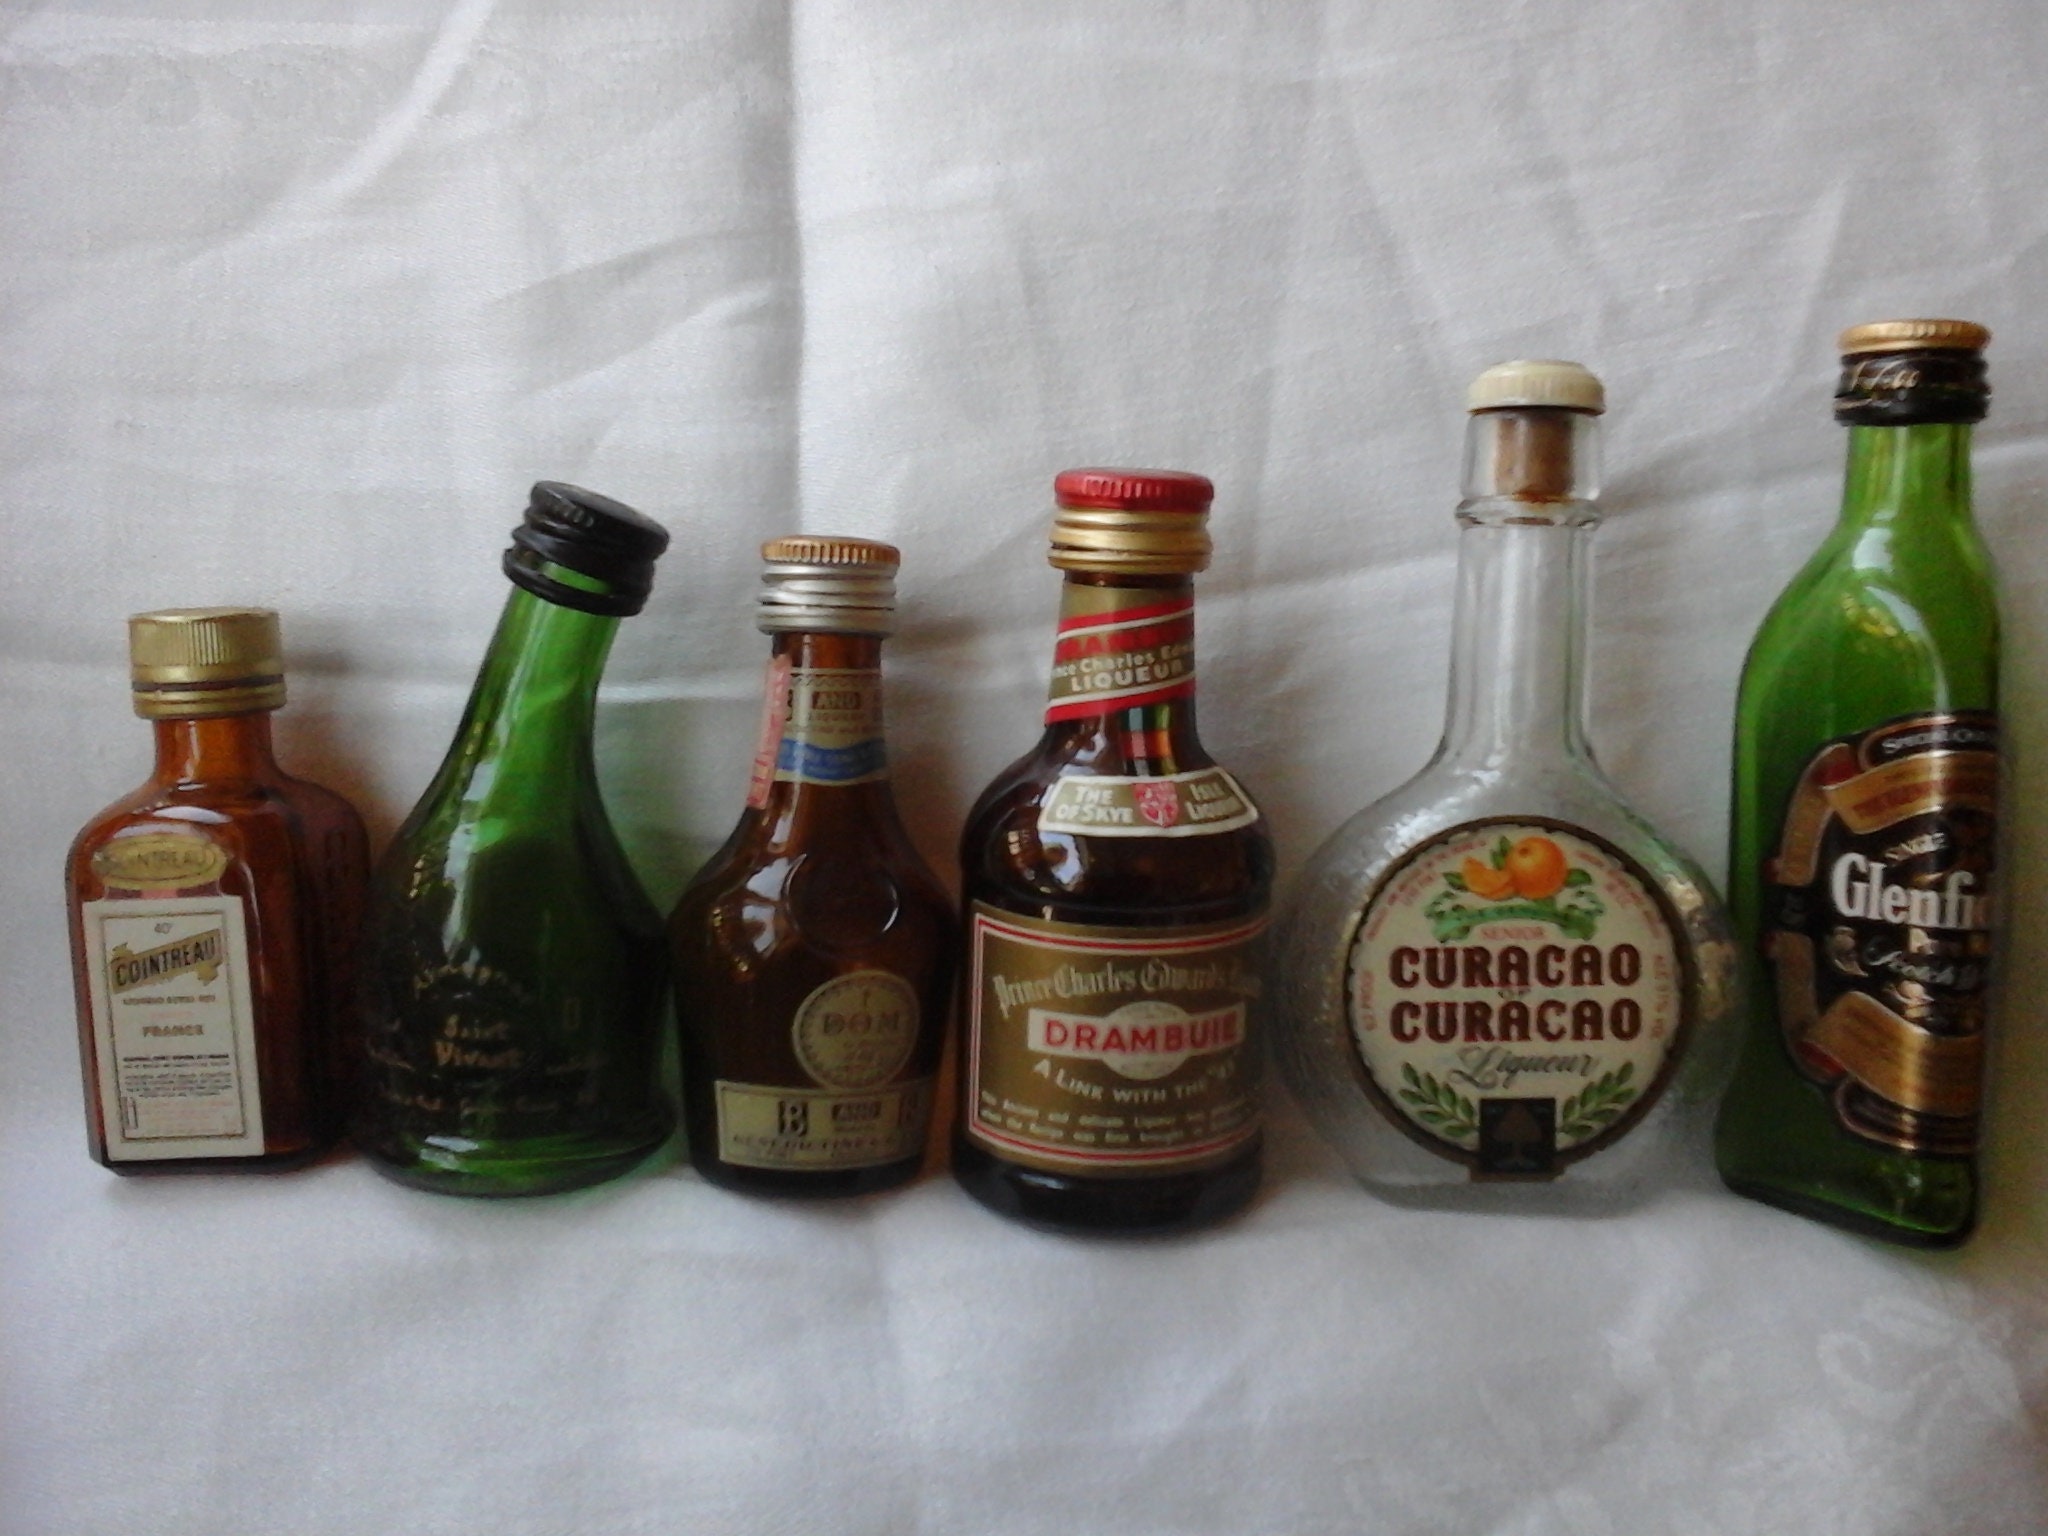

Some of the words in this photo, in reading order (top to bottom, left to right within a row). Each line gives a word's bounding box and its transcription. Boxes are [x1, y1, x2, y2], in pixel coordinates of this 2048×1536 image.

[1071, 658, 1184, 692] LIQUEUR
[1079, 652, 1155, 673] Charles
[1081, 804, 1134, 824] SKYE
[115, 936, 216, 988] COINTREAU
[1043, 1010, 1239, 1052] DRAMBUIE
[1055, 1067, 1104, 1100] LINK
[1112, 1087, 1167, 1104] WITH
